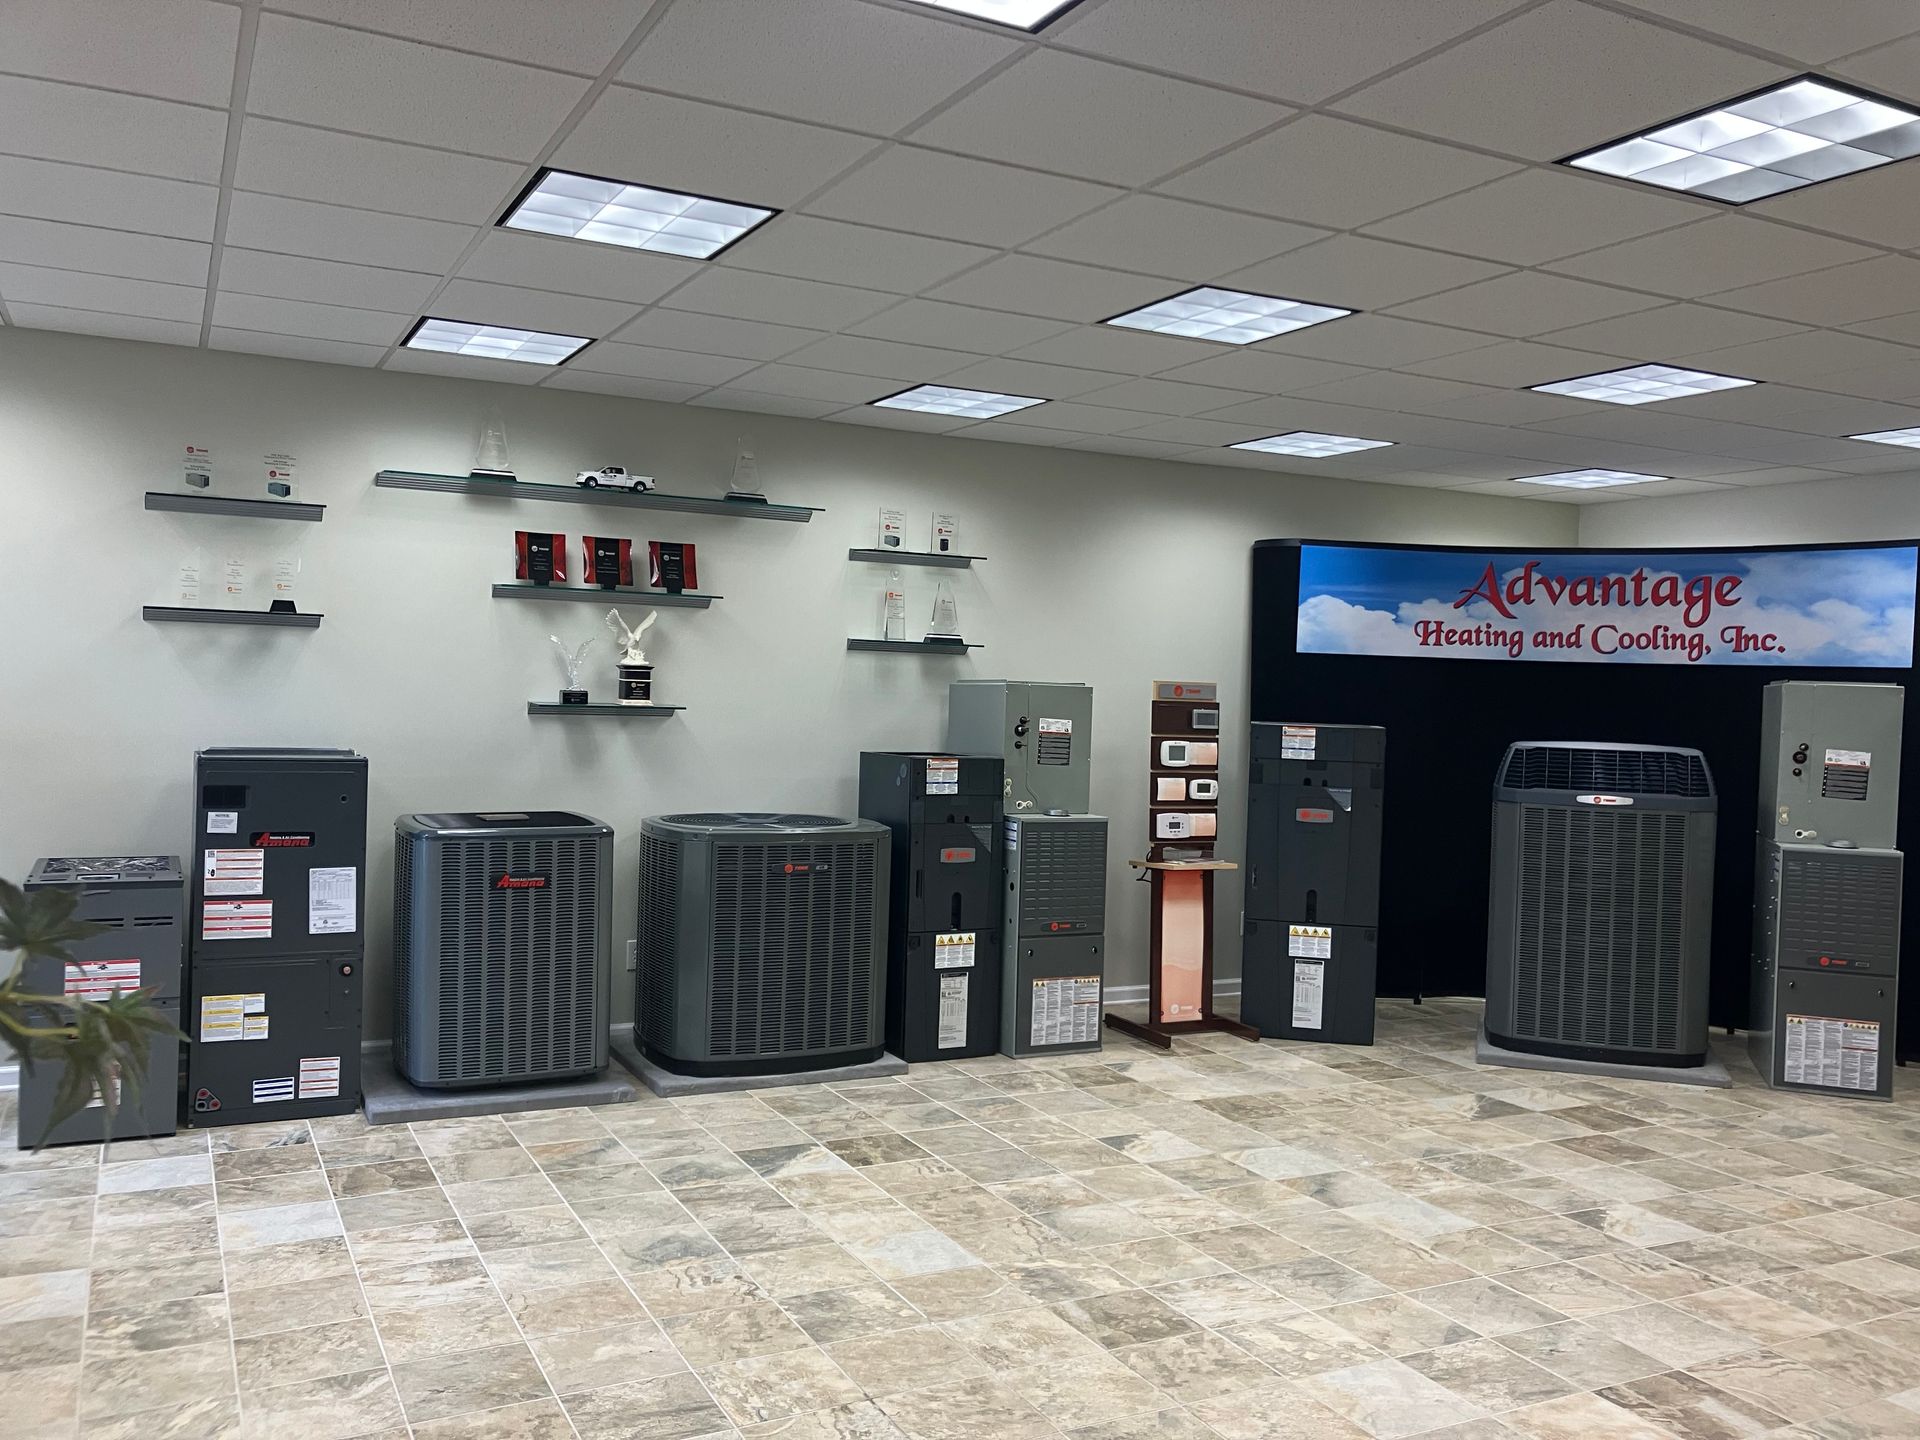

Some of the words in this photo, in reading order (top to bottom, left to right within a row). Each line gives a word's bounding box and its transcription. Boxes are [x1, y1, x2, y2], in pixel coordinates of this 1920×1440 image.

[1453, 561, 1743, 628] Advantage
[1414, 620, 1524, 658] Heating
[1533, 623, 1585, 649] and
[1591, 625, 1712, 662] Cooling,
[1720, 625, 1786, 654] Inc.
